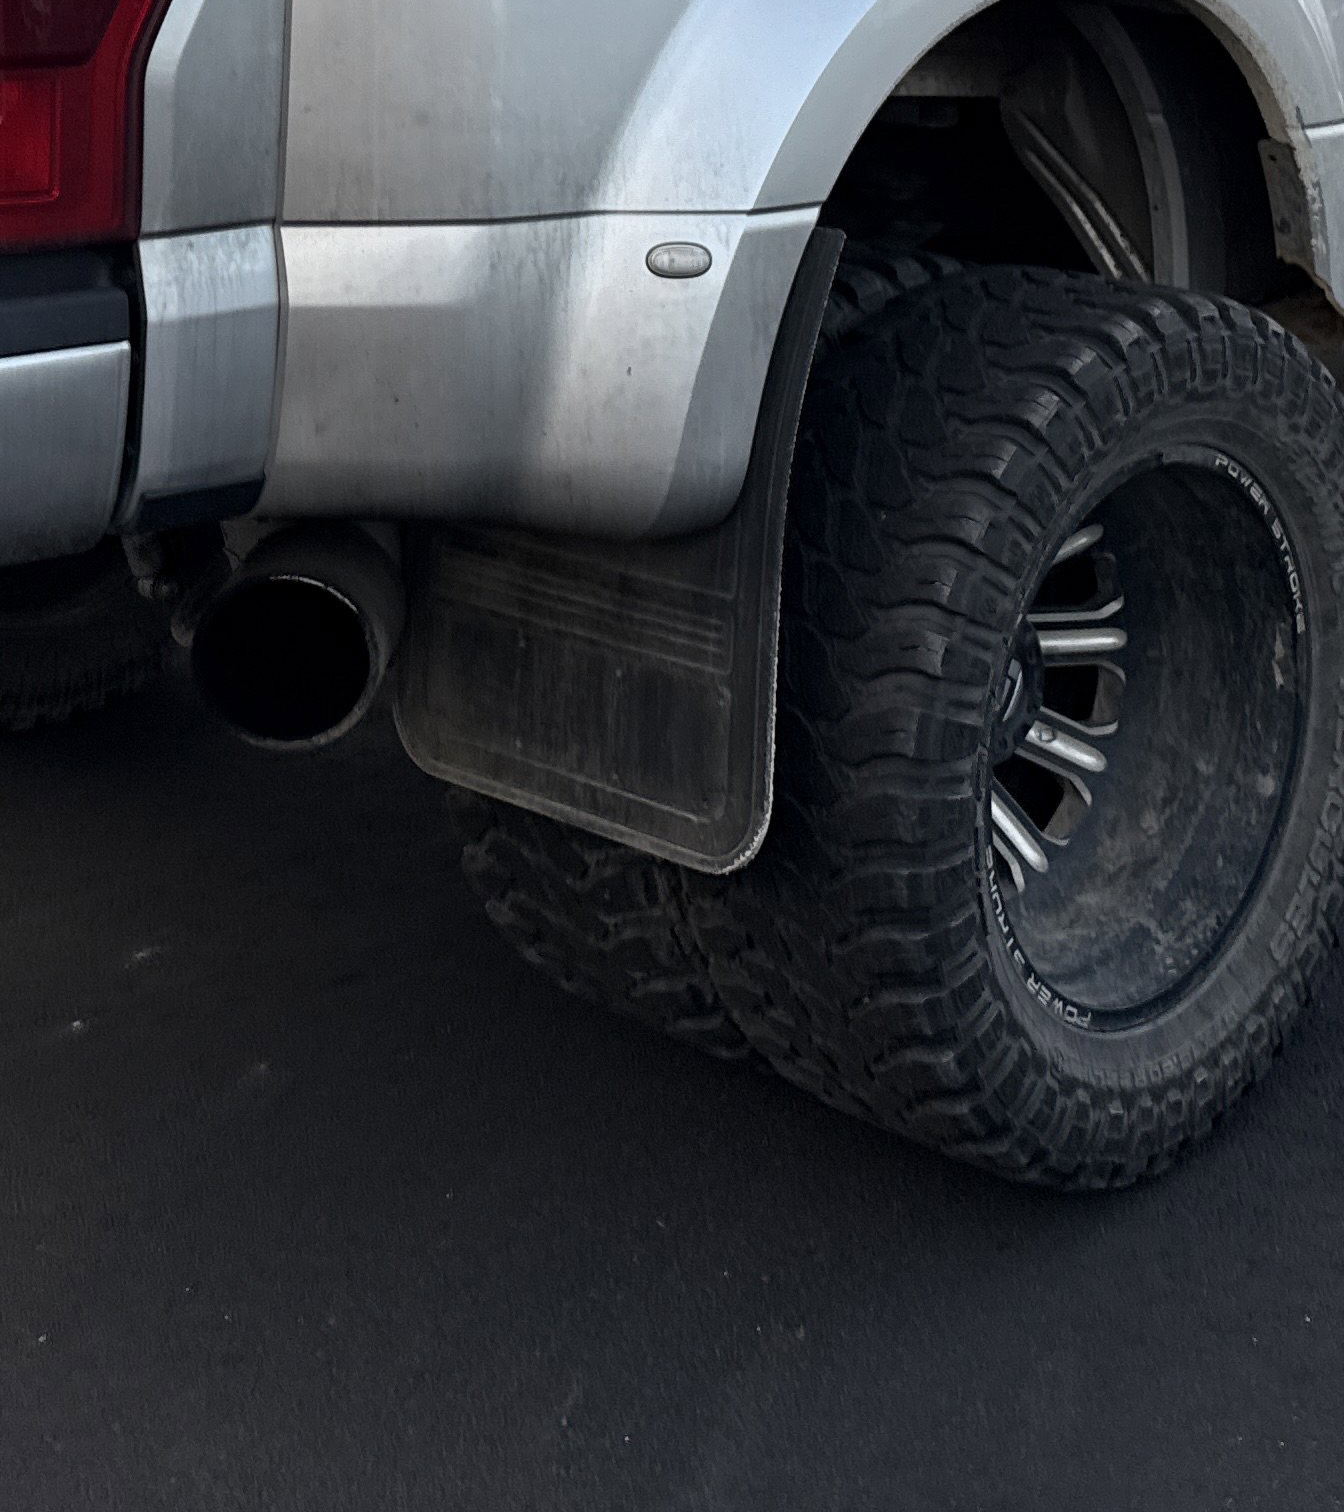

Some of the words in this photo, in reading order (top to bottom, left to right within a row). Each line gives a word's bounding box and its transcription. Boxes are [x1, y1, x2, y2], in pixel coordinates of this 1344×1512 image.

[1213, 453, 1274, 517] POWER
[1269, 517, 1307, 635] STROKE
[1025, 972, 1093, 1030] POWER
